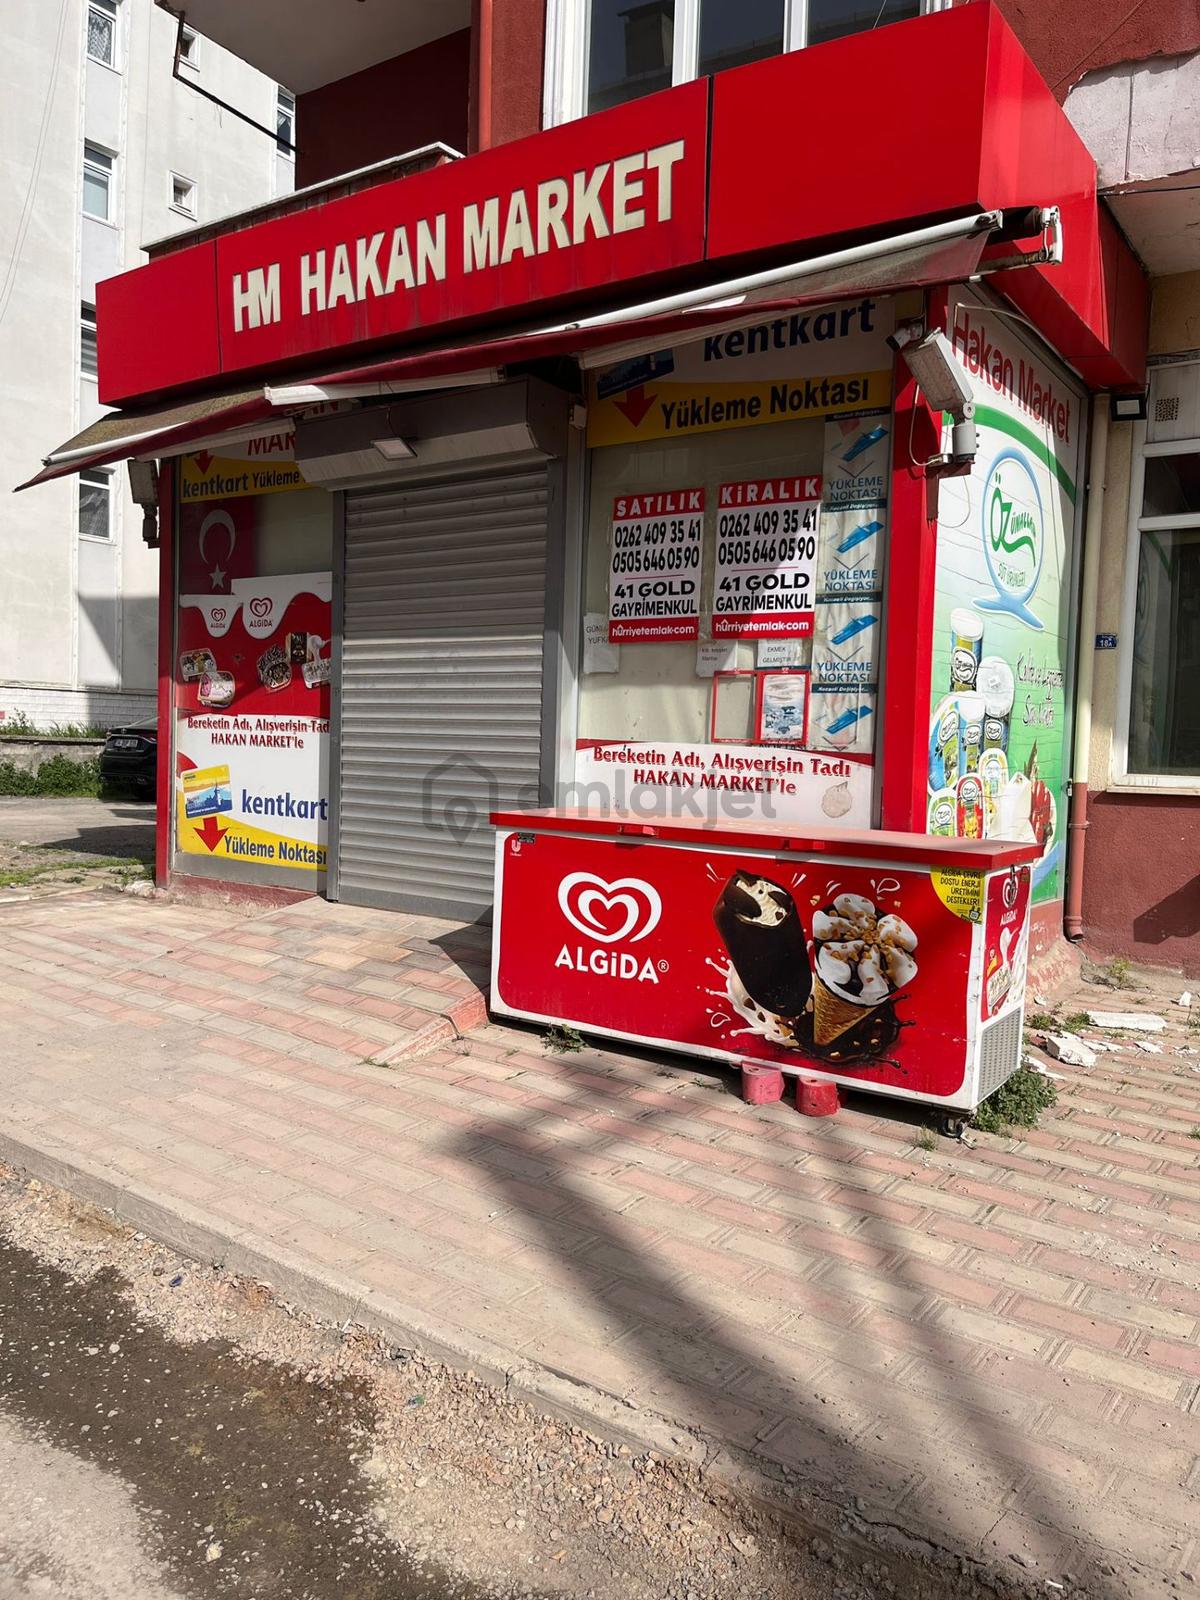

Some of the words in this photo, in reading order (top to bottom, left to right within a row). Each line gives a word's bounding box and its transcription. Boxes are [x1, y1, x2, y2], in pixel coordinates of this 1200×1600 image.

[232, 263, 282, 333] HM
[301, 213, 446, 315] HAKAN
[463, 139, 685, 274] MARKET
[704, 299, 875, 362] kentkart
[951, 312, 1014, 402] Hakan
[1018, 359, 1071, 443] Market
[660, 393, 761, 430] Yükleme
[769, 378, 869, 415] Noktası
[183, 473, 249, 498] kentkart
[252, 469, 300, 489] Yükleme
[830, 488, 881, 501] NOKTASI
[616, 491, 701, 517] SATILIK
[615, 525, 641, 549] 0262
[644, 521, 667, 545] 409
[670, 519, 684, 543] 35
[688, 519, 701, 542] 41
[719, 512, 750, 538] 0262
[753, 510, 779, 535] 409
[783, 509, 798, 533] 35
[802, 508, 817, 531] 41
[612, 550, 641, 574] 0505
[643, 548, 666, 572] 646
[667, 547, 683, 570] 05
[684, 545, 700, 569] 90
[718, 541, 751, 566] 0505
[752, 538, 776, 563] 646
[778, 537, 795, 562] 05
[798, 536, 815, 560] 90
[614, 583, 634, 598] 41
[638, 580, 695, 598] GOLD
[719, 576, 740, 592] 41
[745, 573, 810, 592] GOLD
[823, 569, 878, 581] YÜKLEME
[824, 581, 875, 592] NOKTASI
[817, 660, 873, 672] YÜKLEME
[819, 673, 870, 682] NOKTASI
[187, 716, 230, 730] Bereketin
[233, 717, 252, 733] Adı,
[310, 719, 330, 734] Tad
[211, 733, 246, 746] HAKAN
[250, 734, 304, 749] MARKET'le
[593, 746, 666, 766] Bereketin
[674, 751, 705, 770] Adı,
[711, 752, 803, 774] Alışverişin
[810, 758, 852, 777] Tadı
[633, 768, 694, 789] HAKAN
[699, 773, 797, 795] MARKET'le
[242, 789, 328, 821] kentkart
[224, 835, 275, 858] Yükleme
[279, 841, 327, 865] Noktası
